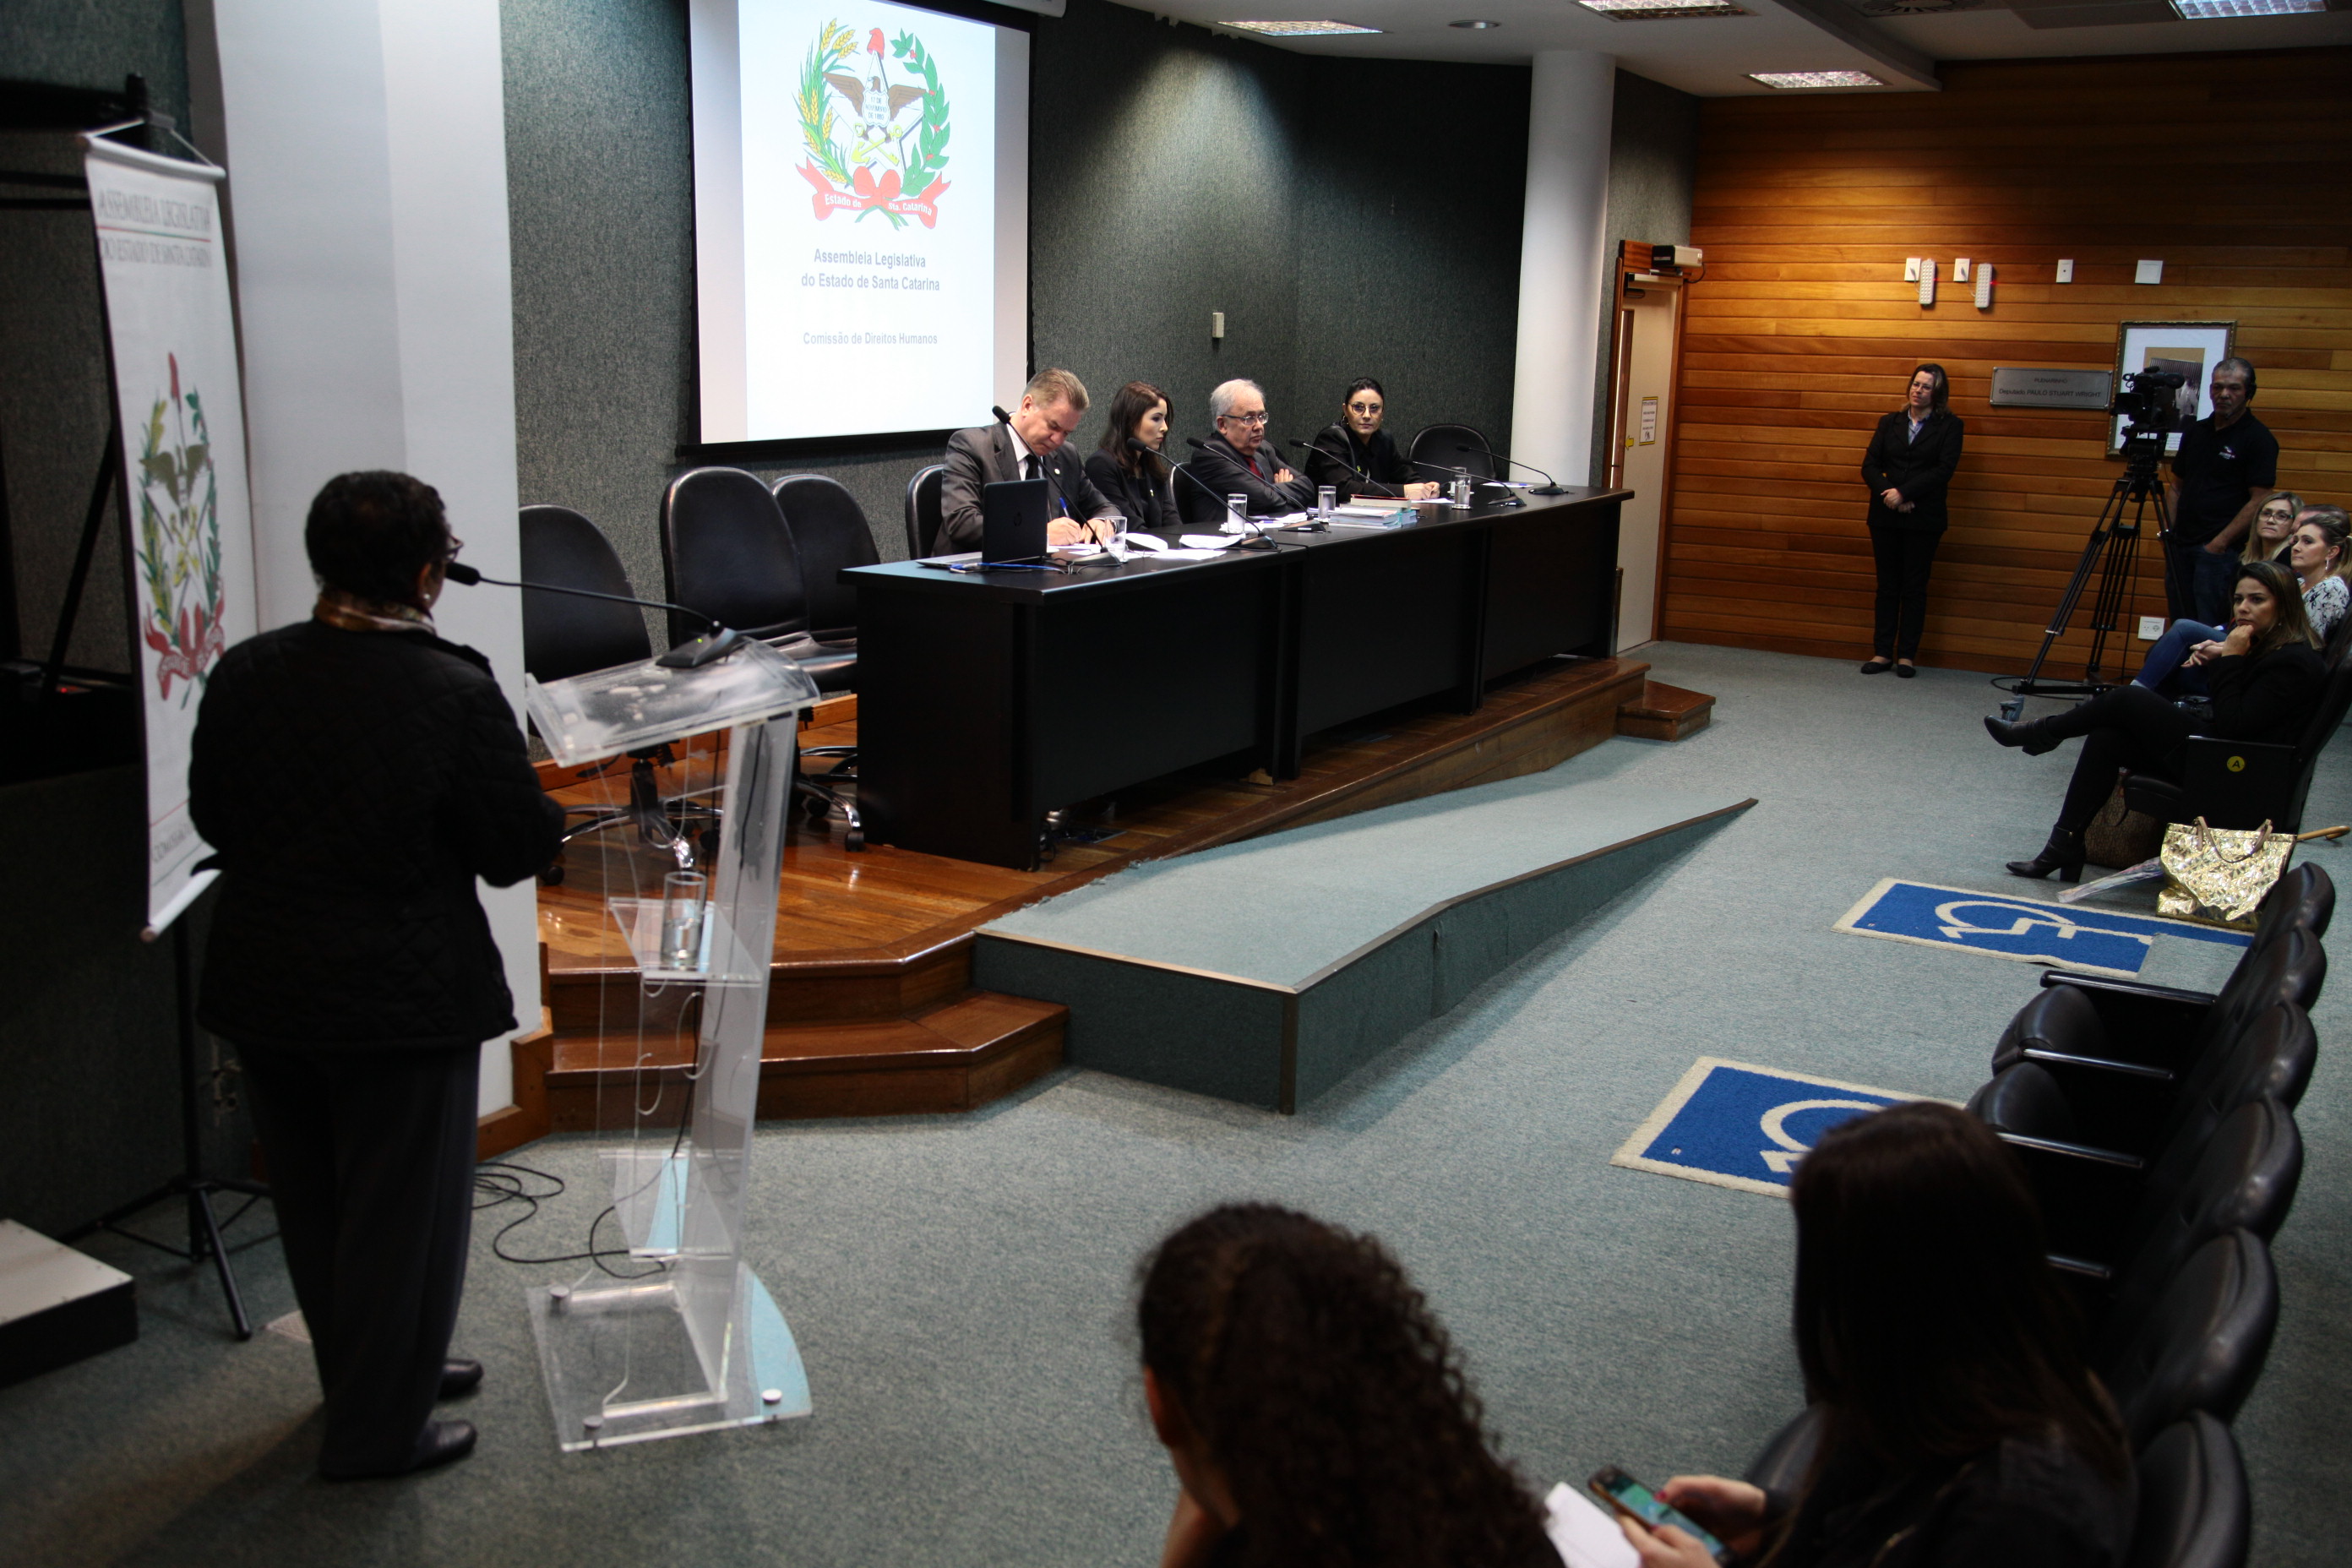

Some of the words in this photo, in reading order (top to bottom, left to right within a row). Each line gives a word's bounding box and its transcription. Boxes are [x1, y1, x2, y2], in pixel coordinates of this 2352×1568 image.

[825, 193, 852, 206] Estado
[852, 199, 862, 208] de
[888, 202, 901, 211] Sta.
[902, 202, 933, 216] Catarina
[814, 248, 873, 265] Assembleia
[874, 252, 926, 270] Legislativa
[801, 272, 815, 286] do
[819, 273, 854, 288] Estado
[857, 275, 869, 288] de
[872, 275, 899, 290] Santa
[901, 276, 940, 291] Catarina
[803, 331, 849, 345] Comissão
[852, 332, 863, 345] de
[864, 331, 897, 345] Direitos
[899, 332, 938, 345] Humanos
[2231, 760, 2240, 769] A
